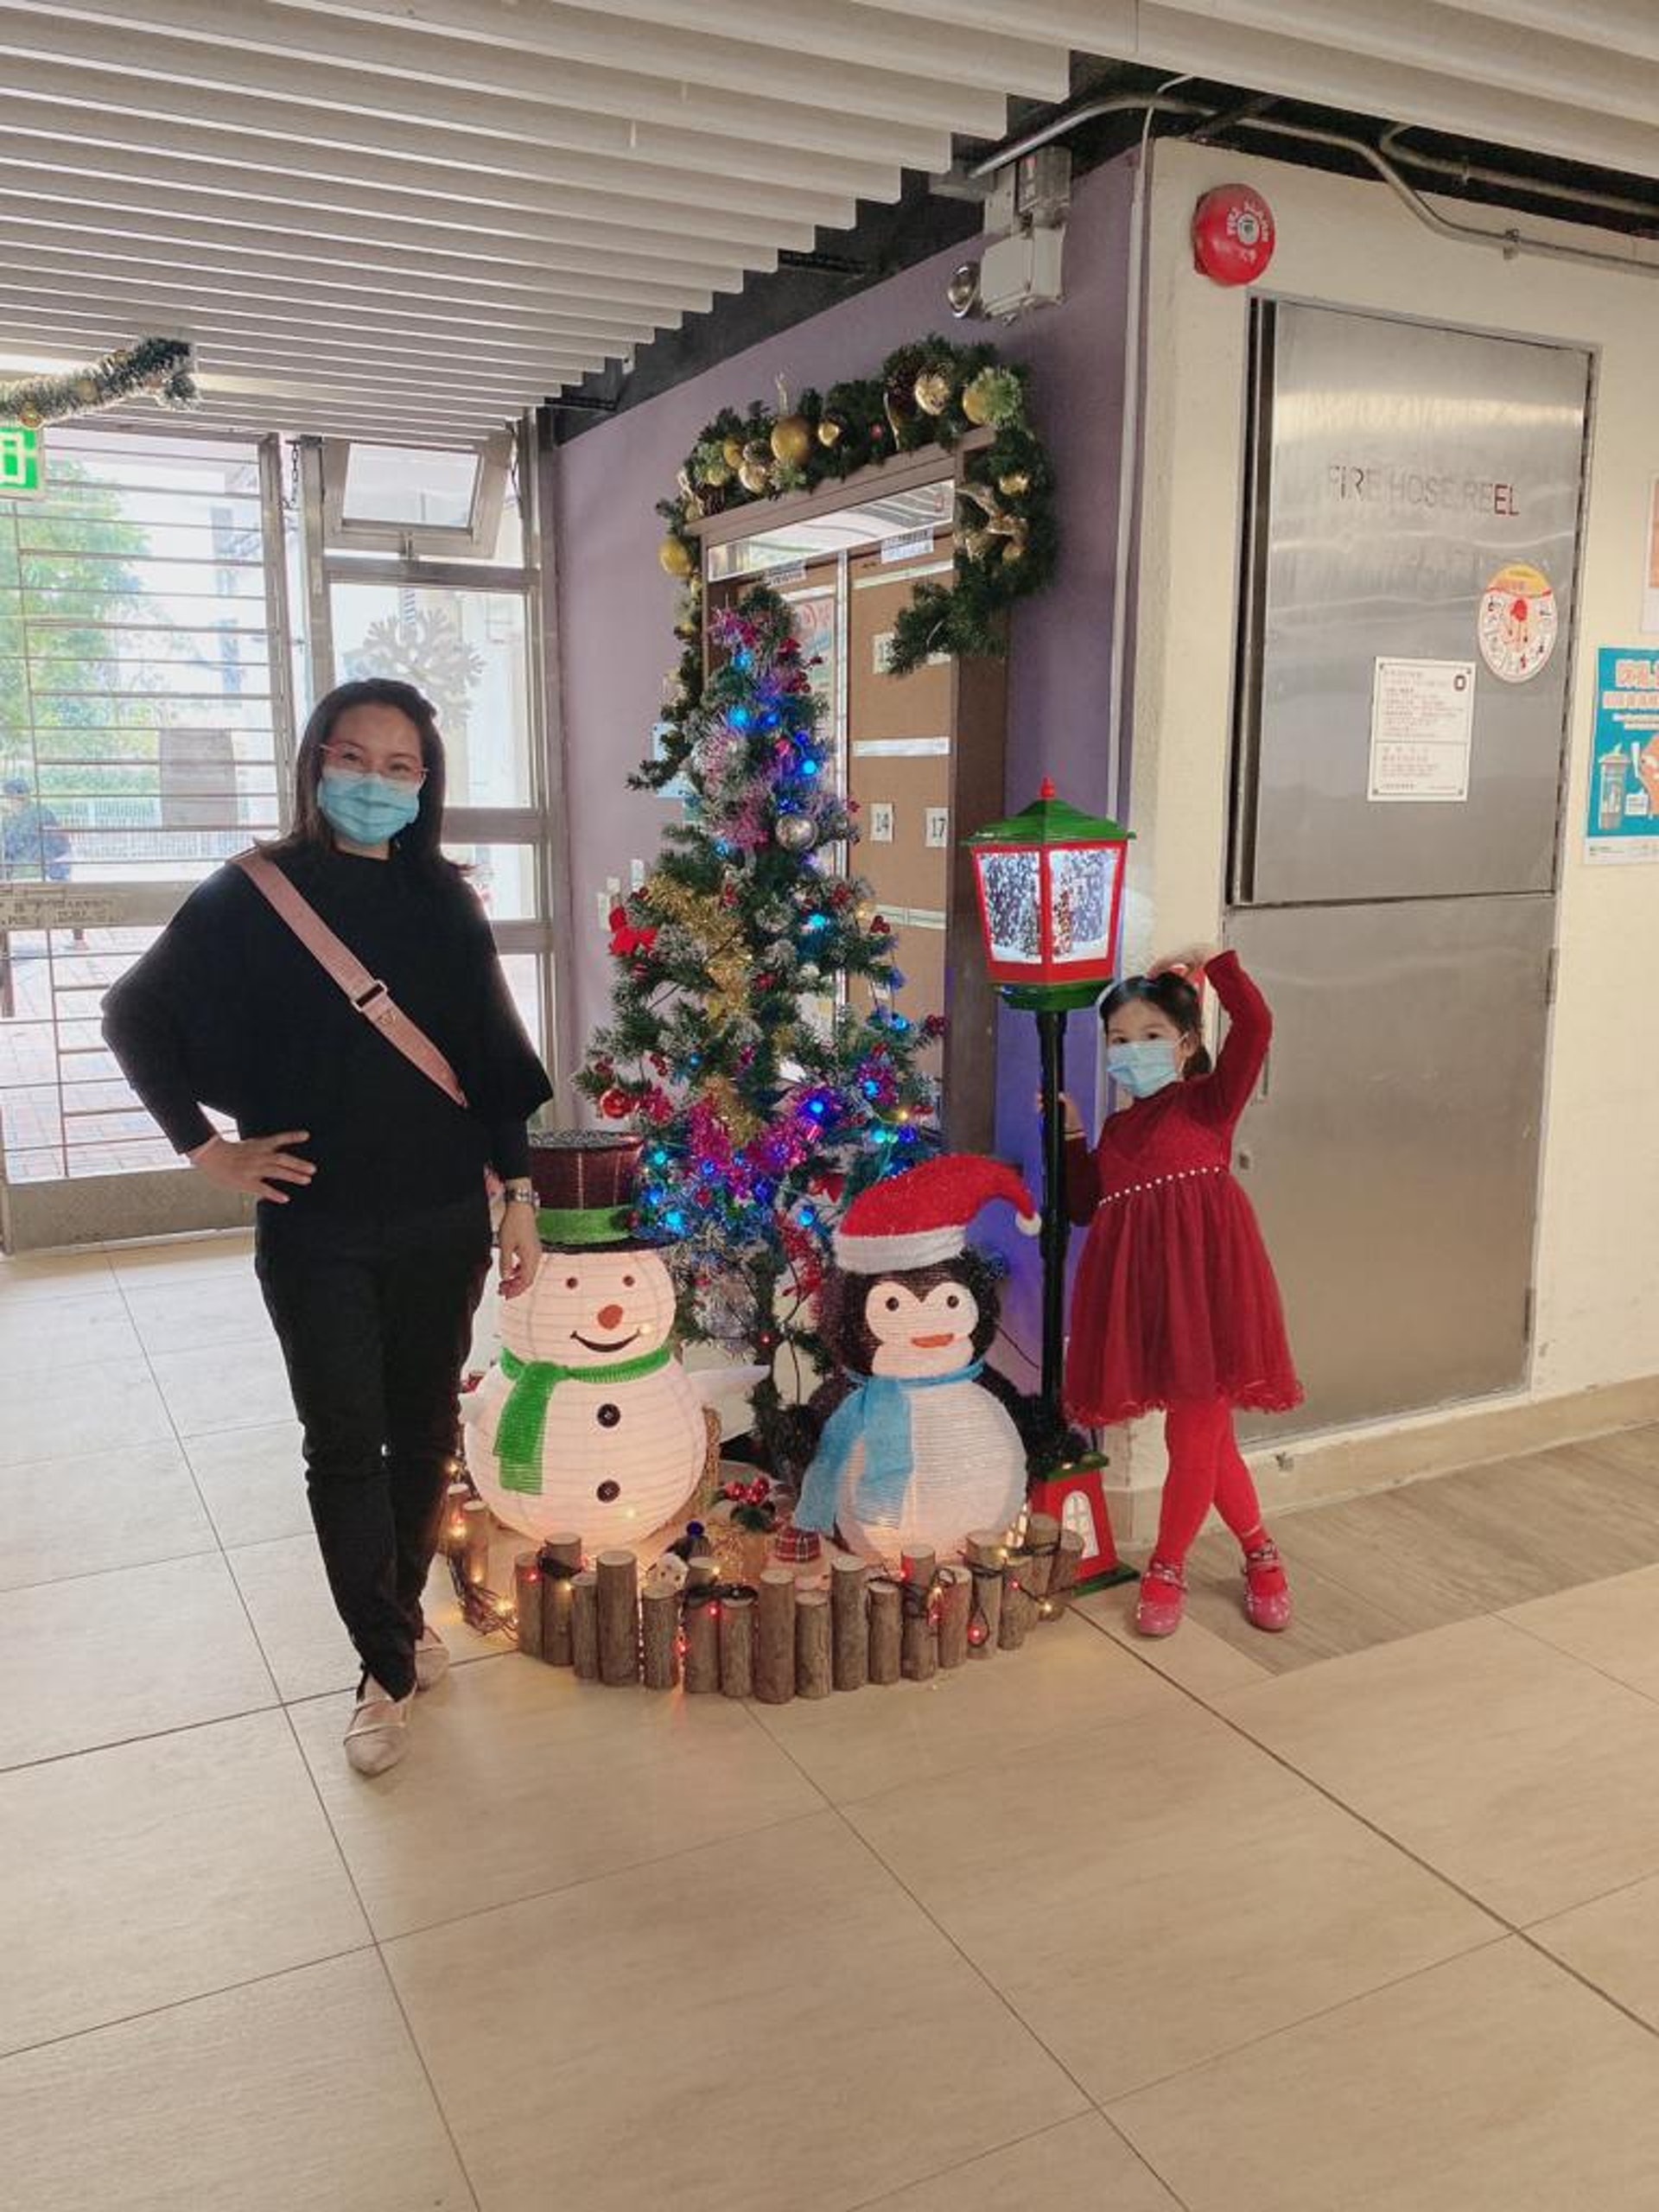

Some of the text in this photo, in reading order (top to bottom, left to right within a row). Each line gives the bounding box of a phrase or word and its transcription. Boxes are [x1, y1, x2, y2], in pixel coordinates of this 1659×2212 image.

[1329, 465, 1520, 516] FIRE HOSE REEL
[931, 816, 946, 838] 17
